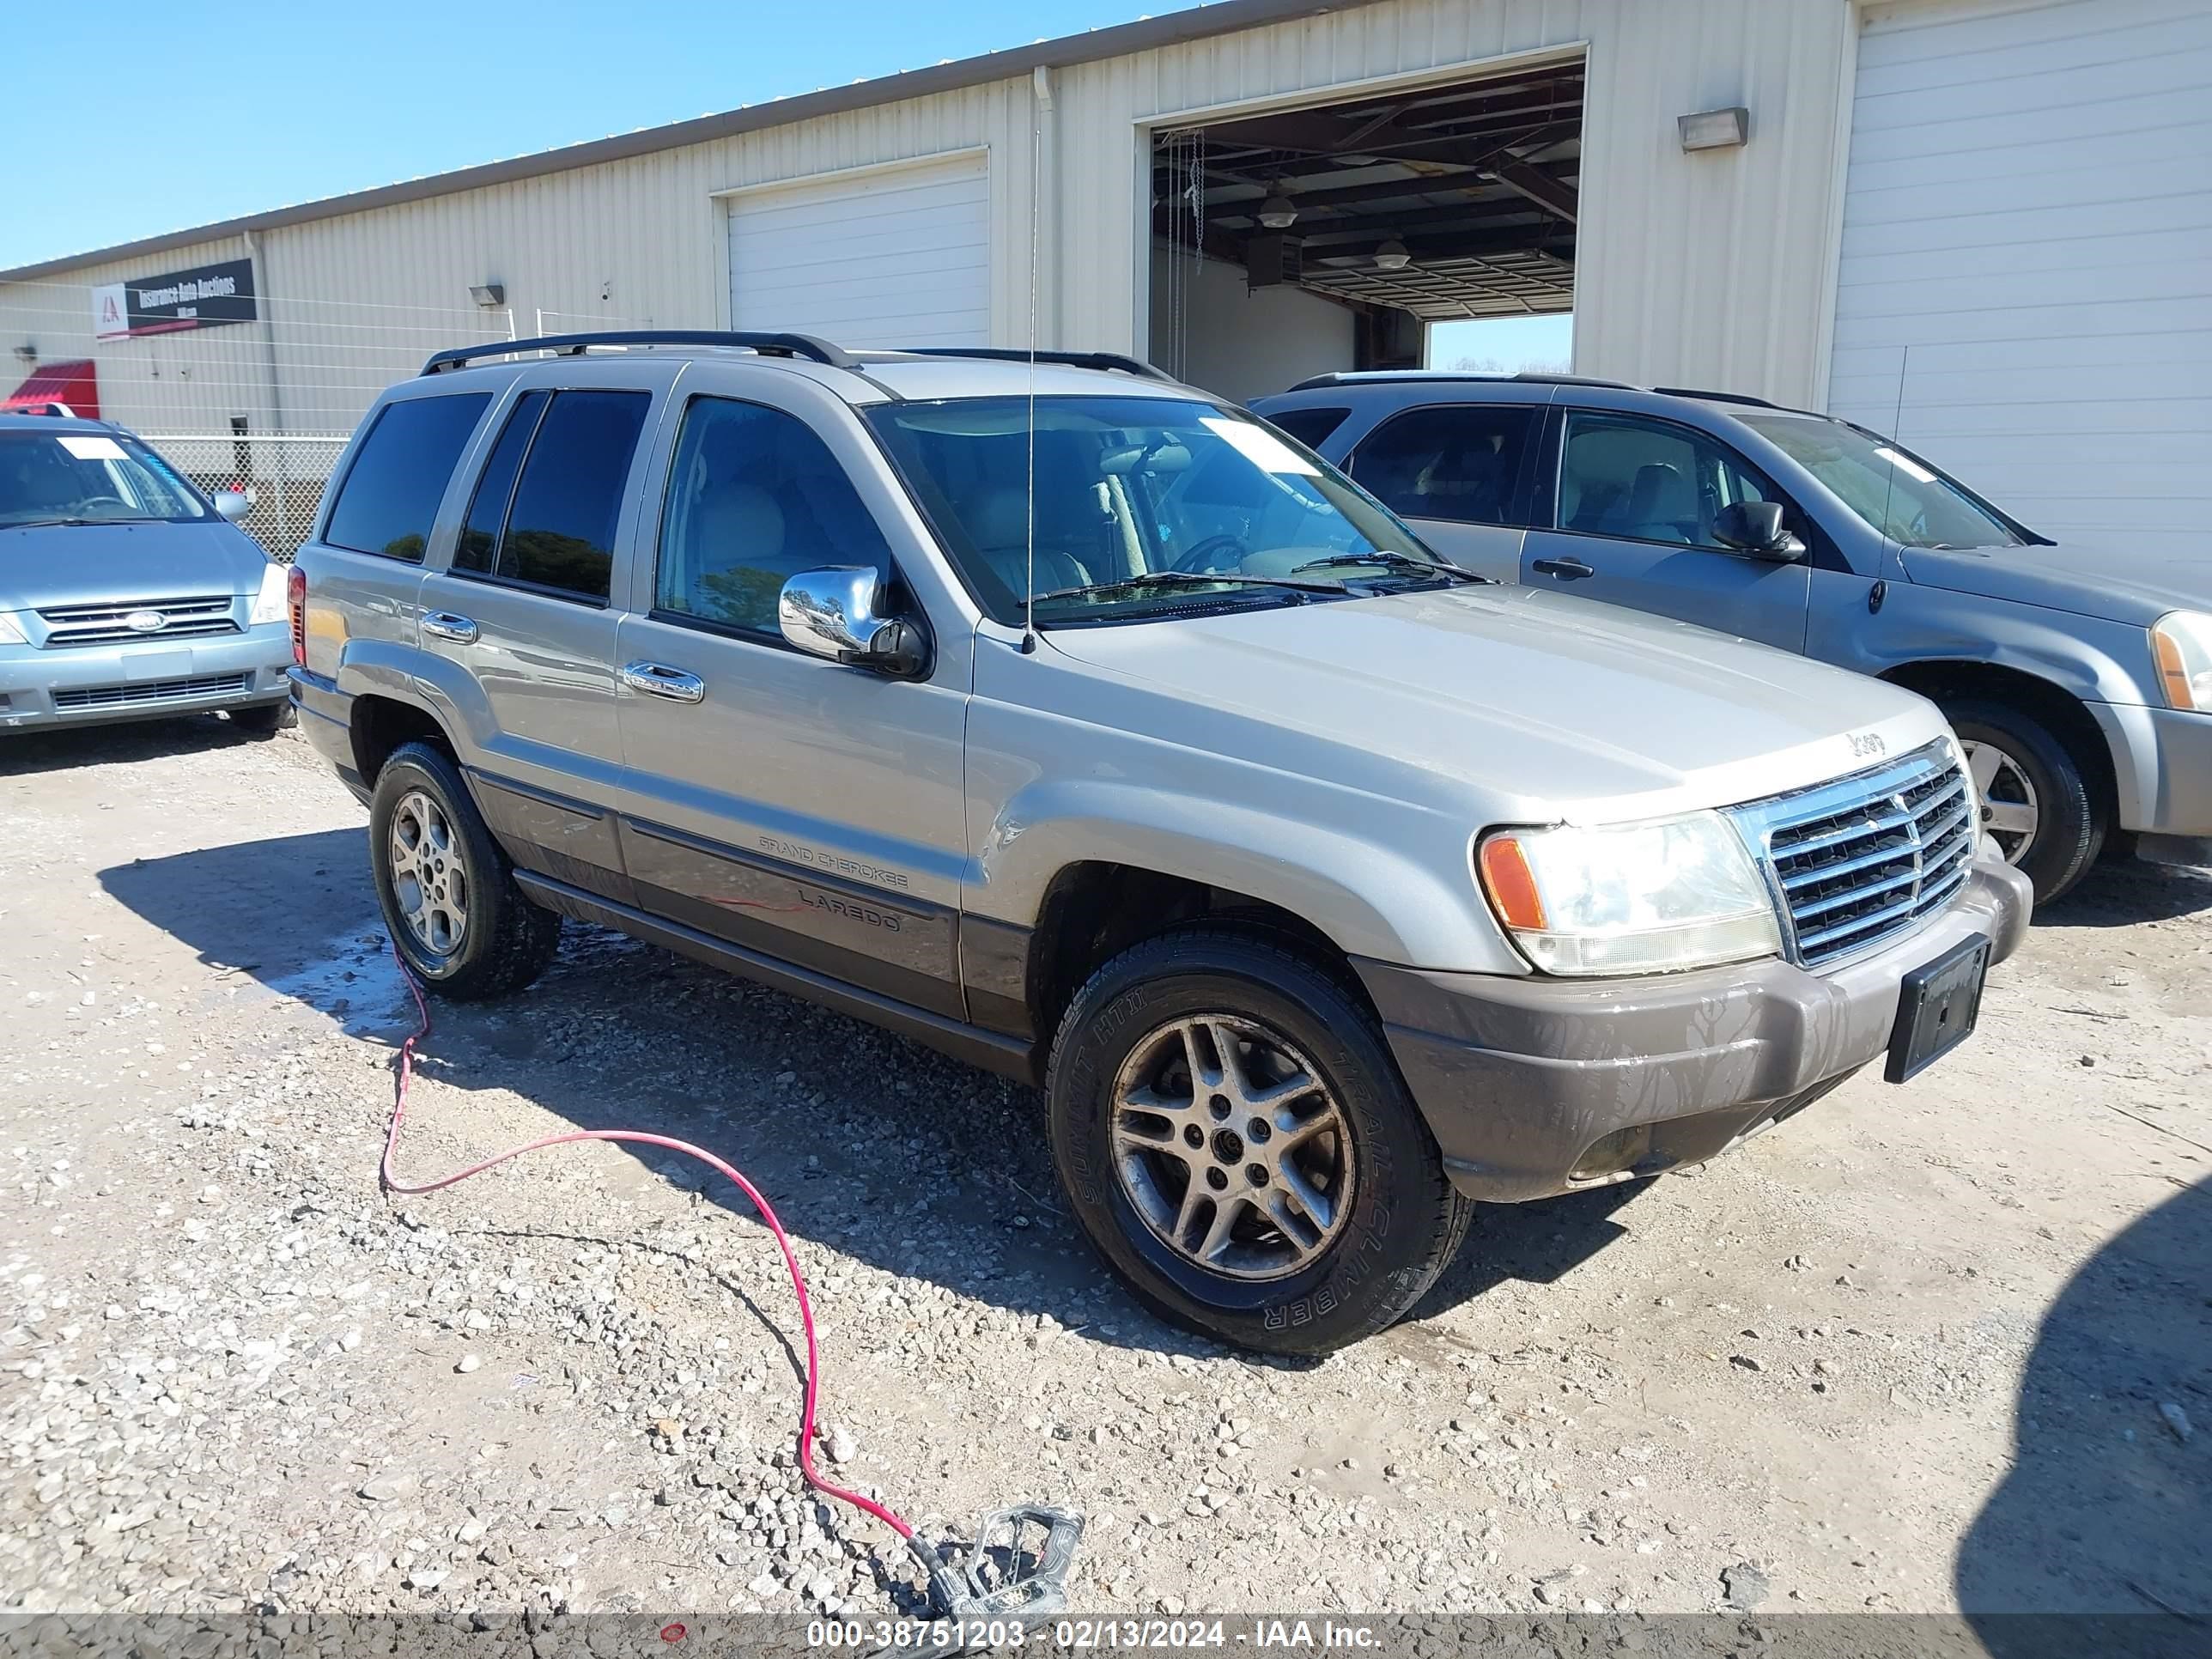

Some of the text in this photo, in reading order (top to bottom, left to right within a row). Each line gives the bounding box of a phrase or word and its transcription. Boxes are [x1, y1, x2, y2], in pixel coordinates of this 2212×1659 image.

[139, 276, 235, 309] Insurance Auto Auctions
[759, 836, 908, 889] GRAND CHEROKEE
[798, 890, 900, 932] LAREDO
[1264, 1051, 1390, 1331] TRAIL CLIMBER
